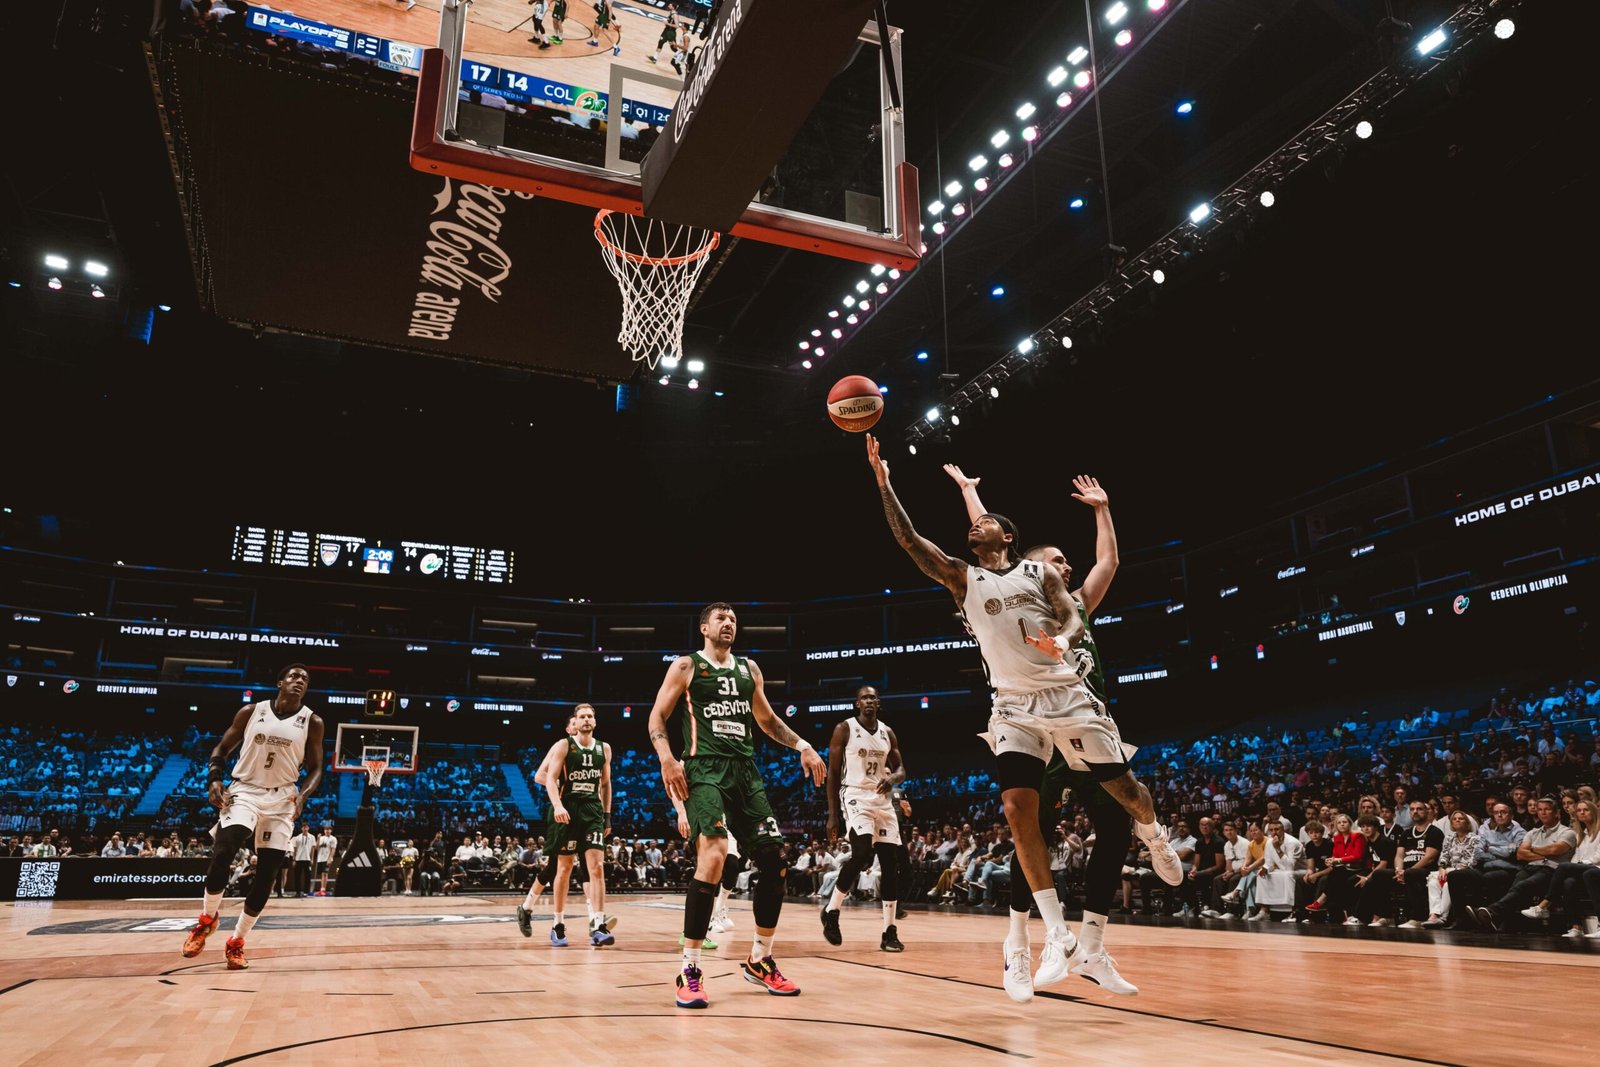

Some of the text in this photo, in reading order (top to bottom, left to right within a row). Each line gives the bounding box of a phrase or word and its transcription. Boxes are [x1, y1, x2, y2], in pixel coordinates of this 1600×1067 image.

[268, 16, 349, 42] PLAYOFFS
[716, 0, 743, 61] arena
[378, 62, 399, 71] FOULS
[470, 64, 528, 91] 17 14
[543, 84, 574, 102] COL
[635, 107, 648, 118] Q1
[407, 291, 461, 341] arena
[838, 401, 876, 416] SPALDING
[1454, 501, 1507, 527] HOME
[1510, 493, 1535, 511] OF
[346, 542, 360, 553] 17
[367, 549, 393, 562] 2:06
[404, 547, 417, 558] 14
[1490, 574, 1568, 601] CEDEVITA OLIMPIJA
[120, 625, 340, 648] HOME OF DUBAI'S BASKETBALL
[1017, 617, 1030, 644] 1
[1318, 620, 1374, 641] DUBAI BASKETBALL
[806, 652, 831, 661] HOME
[840, 649, 856, 658] OF
[858, 645, 904, 657] DUBAI'S
[1117, 669, 1168, 684] CEDEVITA OLIMPIJA
[96, 684, 158, 696] CEDEVITA OLIMPIJA
[716, 676, 740, 696] 31
[328, 696, 346, 704] DUBAI
[474, 702, 524, 712] CEDEVITA OLIMPIJA
[809, 702, 854, 712] CEDEVITA OLIMPIJA
[703, 699, 752, 719] CEDEVITA
[264, 752, 276, 770] 5
[581, 753, 594, 767] 11
[767, 816, 783, 838] 3
[591, 831, 604, 846] 11
